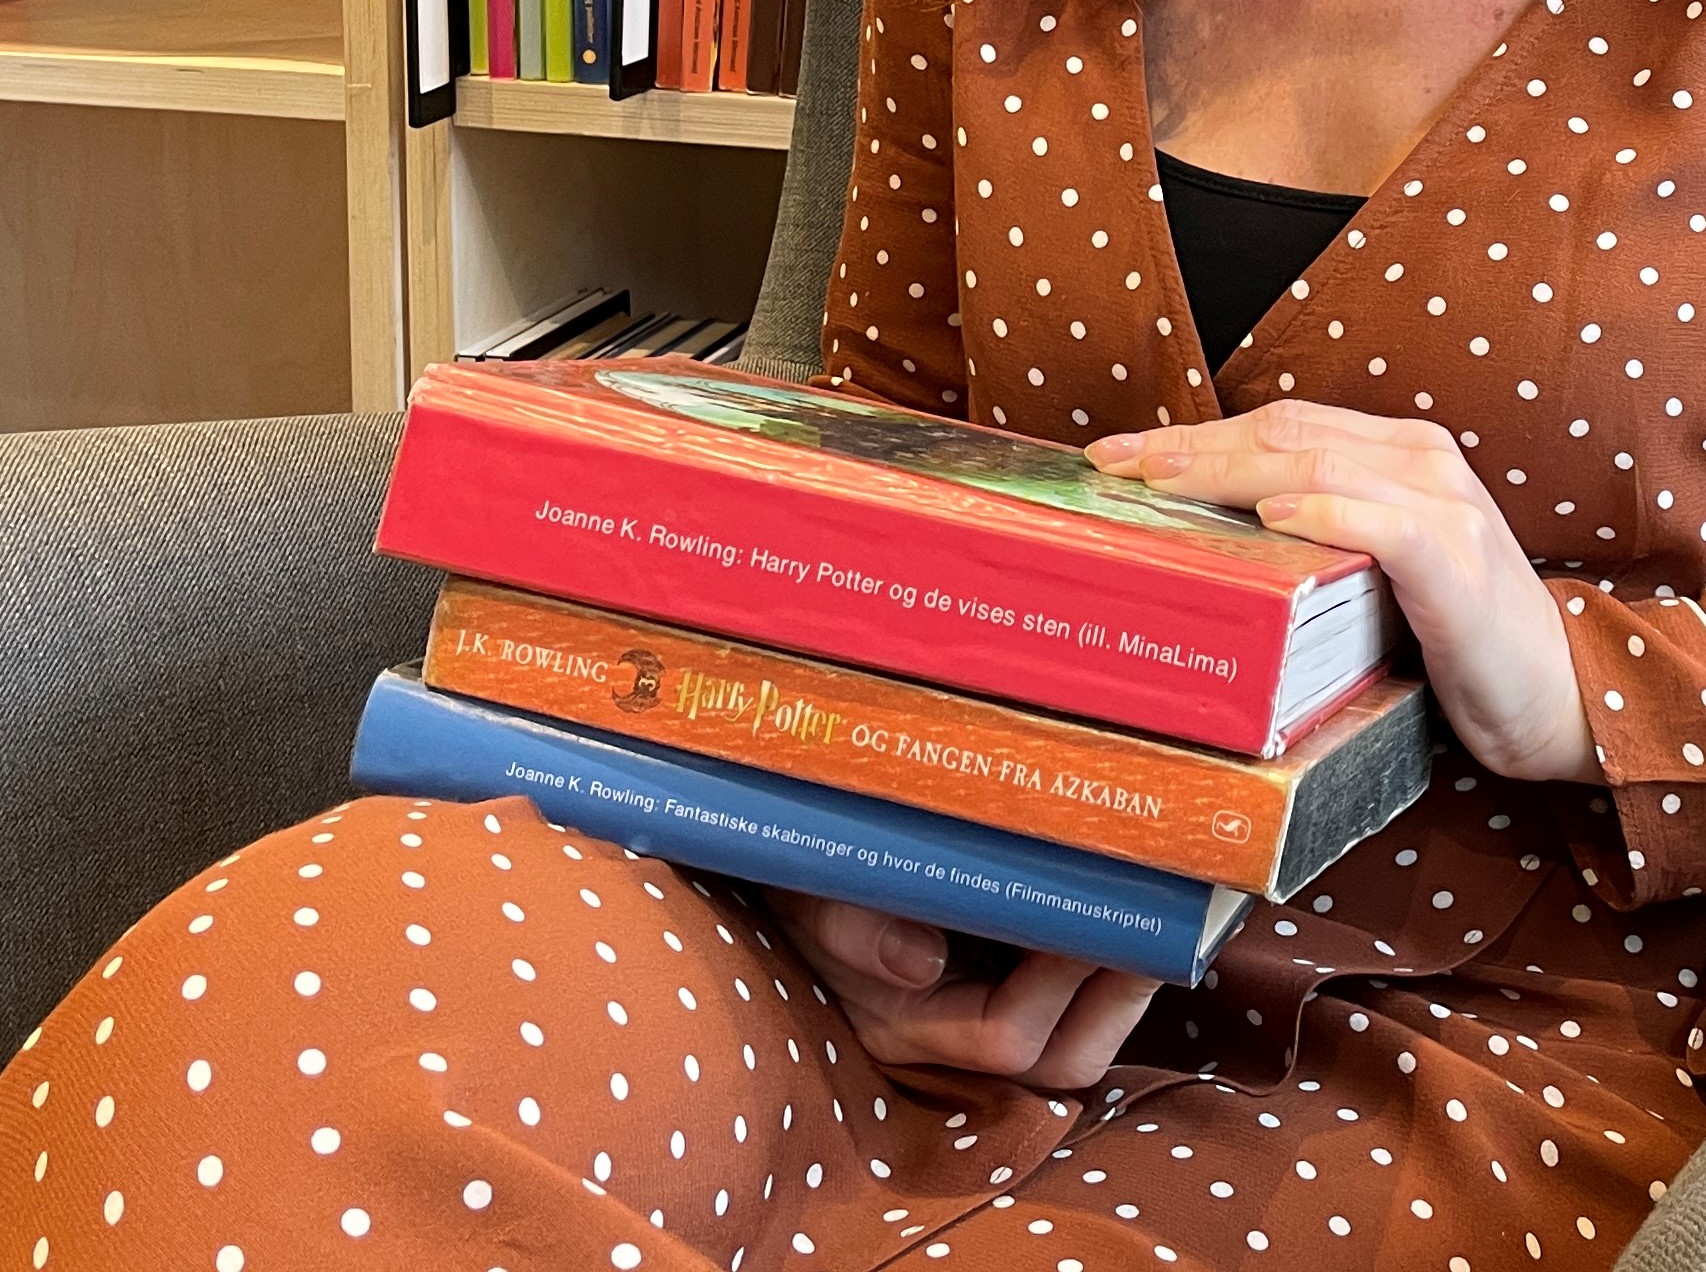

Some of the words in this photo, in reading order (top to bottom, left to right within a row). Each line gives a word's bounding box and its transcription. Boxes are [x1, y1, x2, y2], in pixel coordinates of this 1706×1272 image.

[534, 500, 614, 536] Joanne
[620, 518, 642, 541] K.
[648, 524, 742, 568] Rowling:
[750, 548, 812, 584] Harry
[816, 562, 883, 596] Potter
[890, 583, 918, 609] og
[923, 588, 951, 612] de
[958, 596, 1015, 626] vises
[1022, 612, 1071, 639] sten
[1077, 621, 1111, 648] (ill.
[1118, 630, 1238, 684] MinaLima)
[456, 629, 493, 656] J.K.
[500, 640, 608, 684] ROWLING
[674, 667, 754, 722] Harry
[749, 680, 843, 746] Potter
[850, 724, 889, 753] OG
[895, 734, 992, 776] FANGEN
[998, 760, 1042, 791] FRA
[1049, 774, 1162, 819] AZKABAN
[505, 762, 565, 788] Joanne
[568, 775, 586, 794] K.
[589, 780, 660, 813] Rowling:
[664, 799, 758, 836] Fantastiske
[762, 824, 854, 858] skabninger
[856, 848, 879, 866] og
[883, 854, 921, 874] hvor
[925, 863, 945, 880] de
[949, 868, 1000, 894] findes
[1004, 880, 1162, 935] (Filmmanuskriptet)
